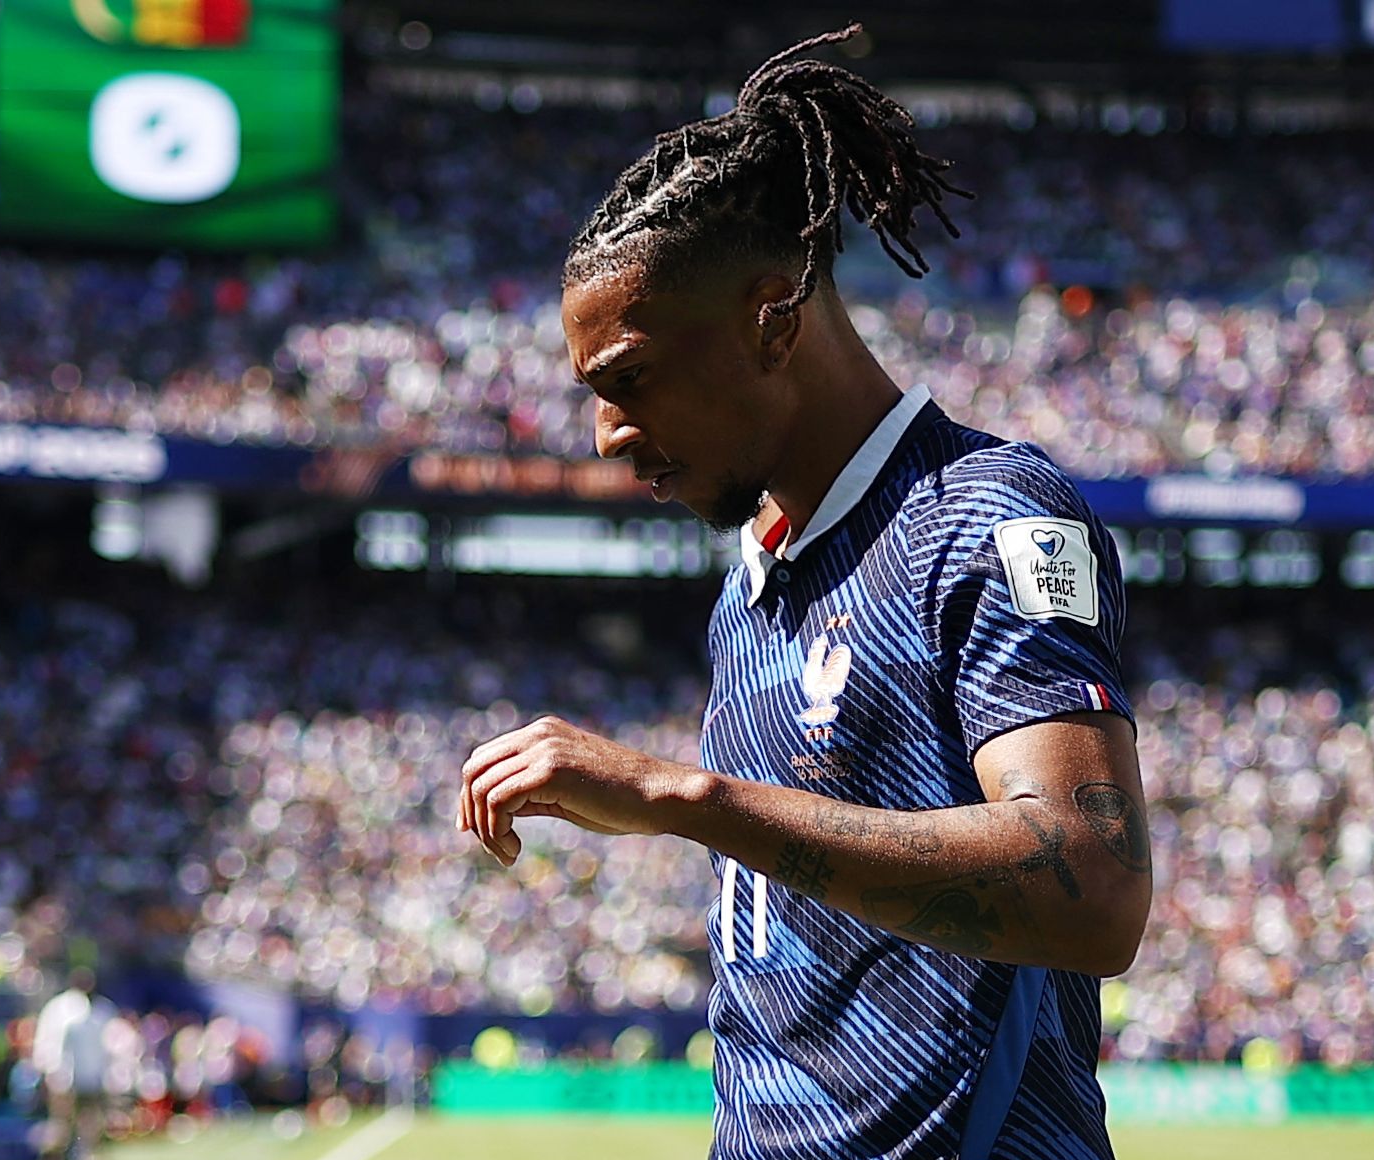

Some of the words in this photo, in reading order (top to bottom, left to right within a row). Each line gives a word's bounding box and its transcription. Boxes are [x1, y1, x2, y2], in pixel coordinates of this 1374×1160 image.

[1036, 577, 1077, 598] PEACE
[1049, 596, 1070, 608] FIFA
[806, 727, 834, 742] FFF
